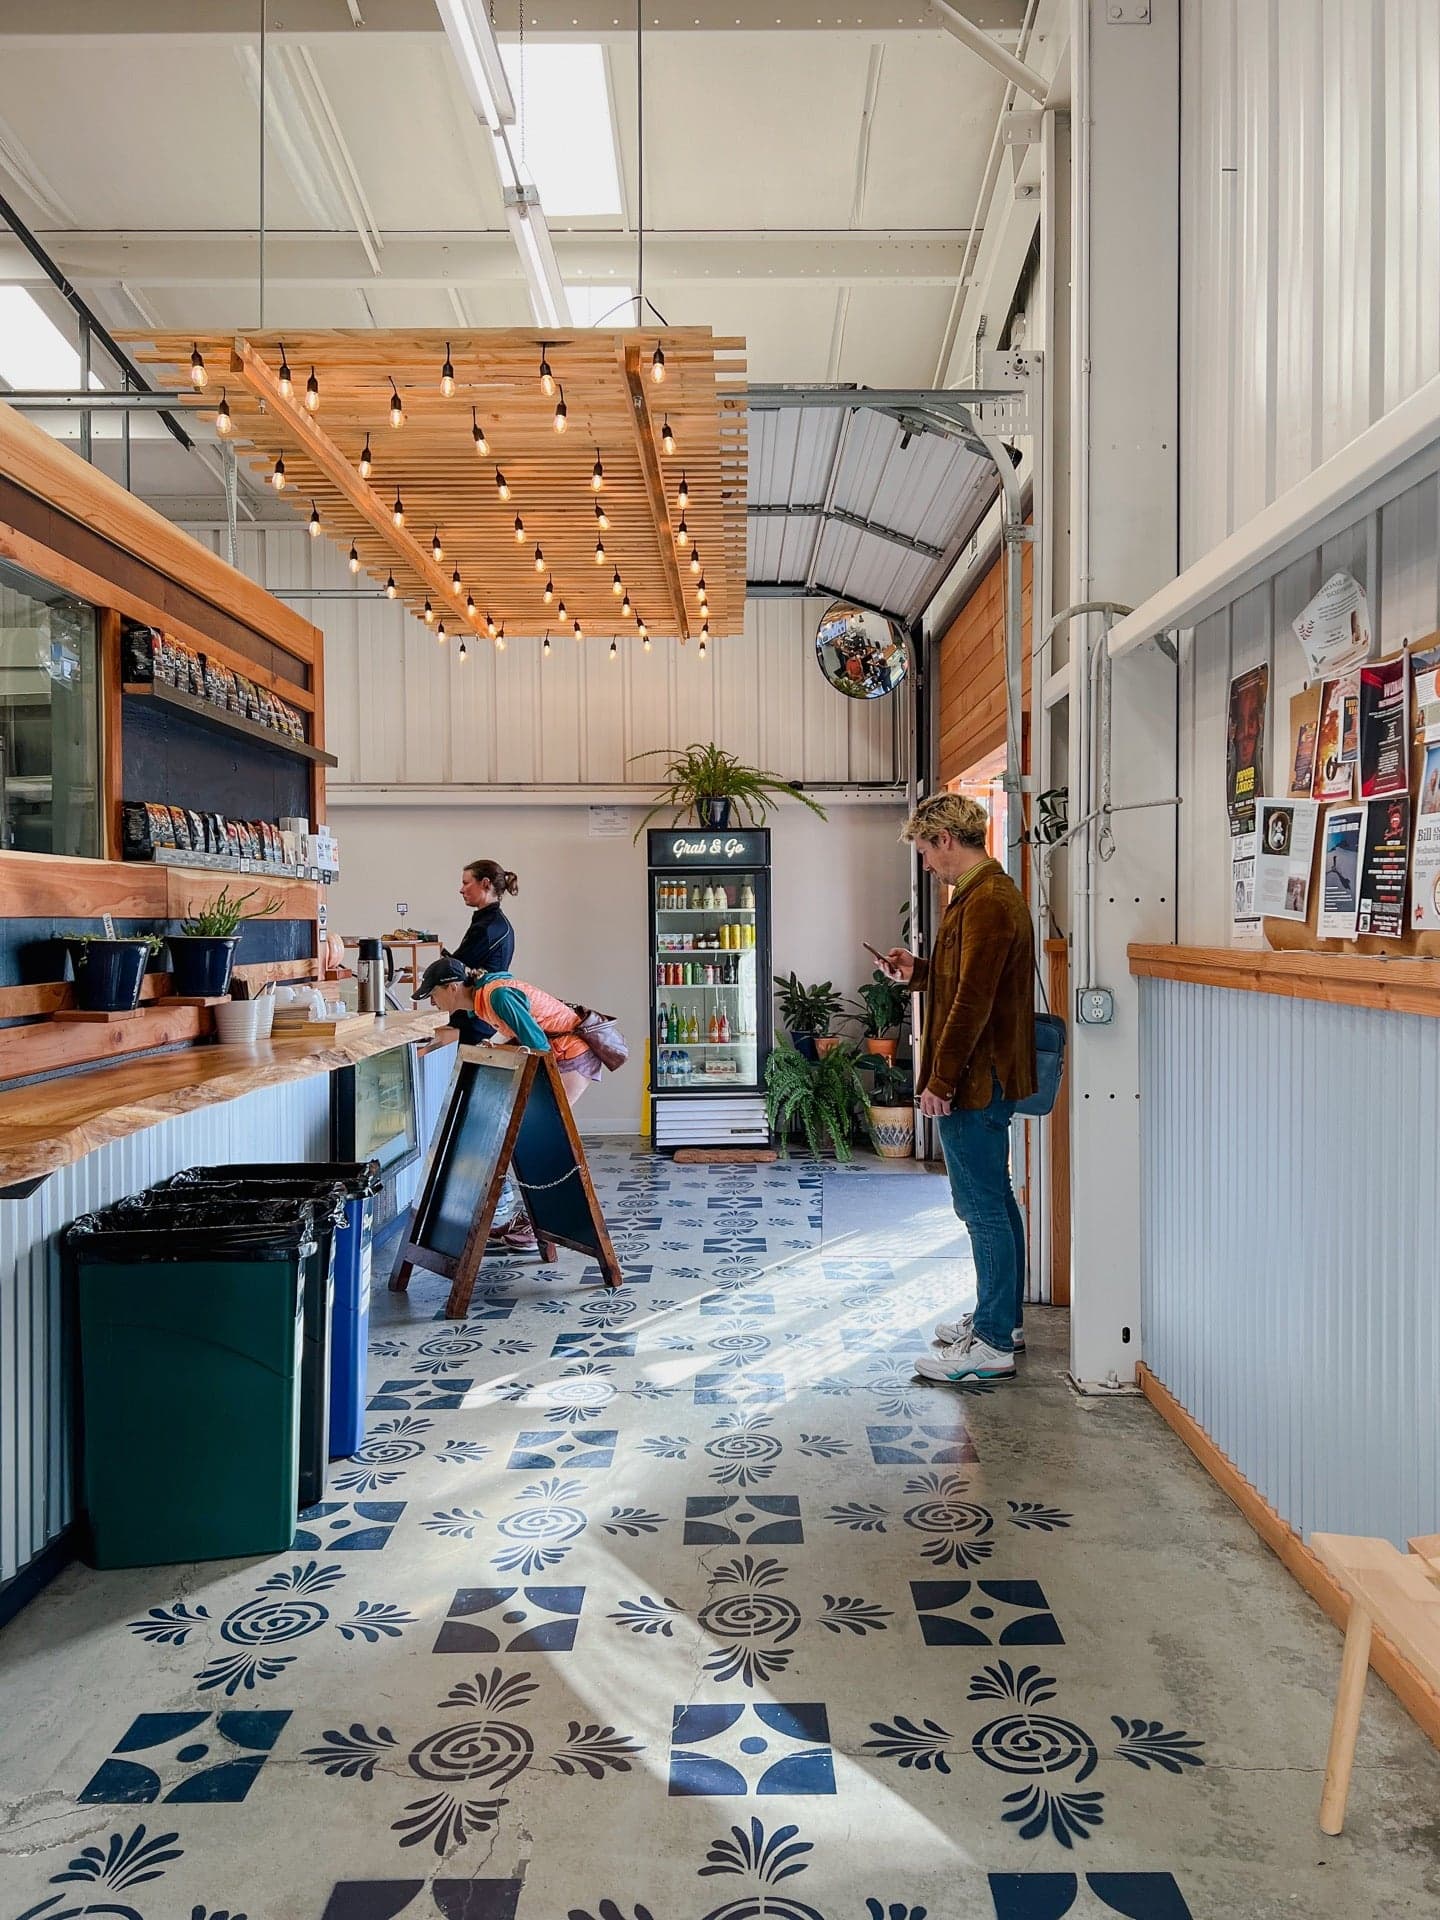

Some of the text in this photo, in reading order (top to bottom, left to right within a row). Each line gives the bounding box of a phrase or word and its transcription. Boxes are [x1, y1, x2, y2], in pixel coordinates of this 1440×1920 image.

[1417, 827, 1431, 841] Bill
[673, 838, 746, 858] Grab & Go
